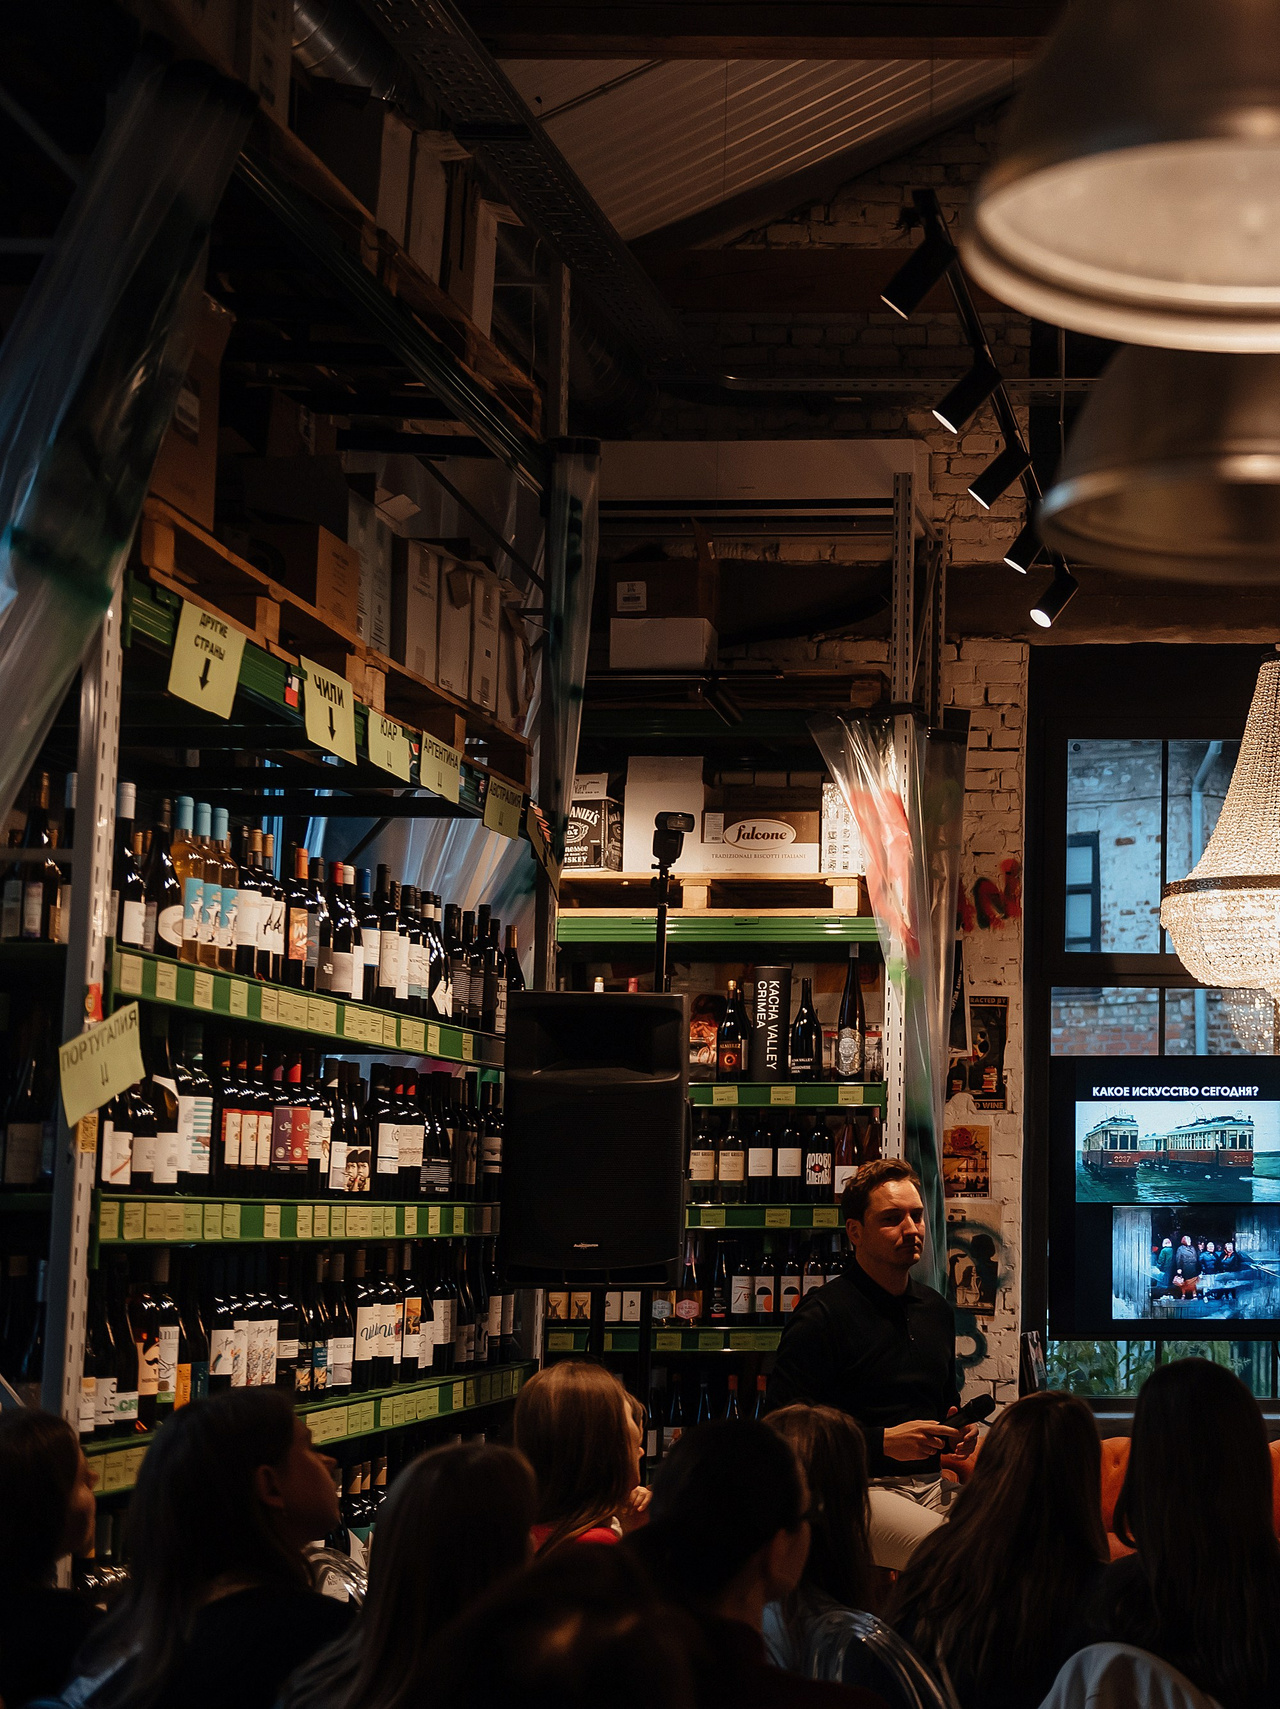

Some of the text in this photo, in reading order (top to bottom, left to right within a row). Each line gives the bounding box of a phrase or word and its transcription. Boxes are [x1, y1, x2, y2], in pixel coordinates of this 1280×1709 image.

[199, 612, 229, 639] ДРУГИЕ
[194, 634, 226, 661] СТРАНЫ
[313, 674, 345, 709] ЧИЛИ
[380, 717, 397, 741] ЮАР
[423, 737, 459, 770] АРГЕНТИНА
[488, 781, 521, 808] АВСТРАЛИЯ
[569, 806, 600, 827] ANIEL'S
[733, 825, 787, 843] falcone
[756, 980, 767, 1029] CRIMEA
[969, 996, 995, 1004] RACTED
[766, 980, 780, 1070] KACHA VALLEY
[62, 1008, 137, 1071] ПОРТУГАЛИЯ
[982, 1101, 1004, 1109] WINE
[1092, 1086, 1259, 1097] КАКОЕ ИСКУССТВО СЕГОДНЯ?
